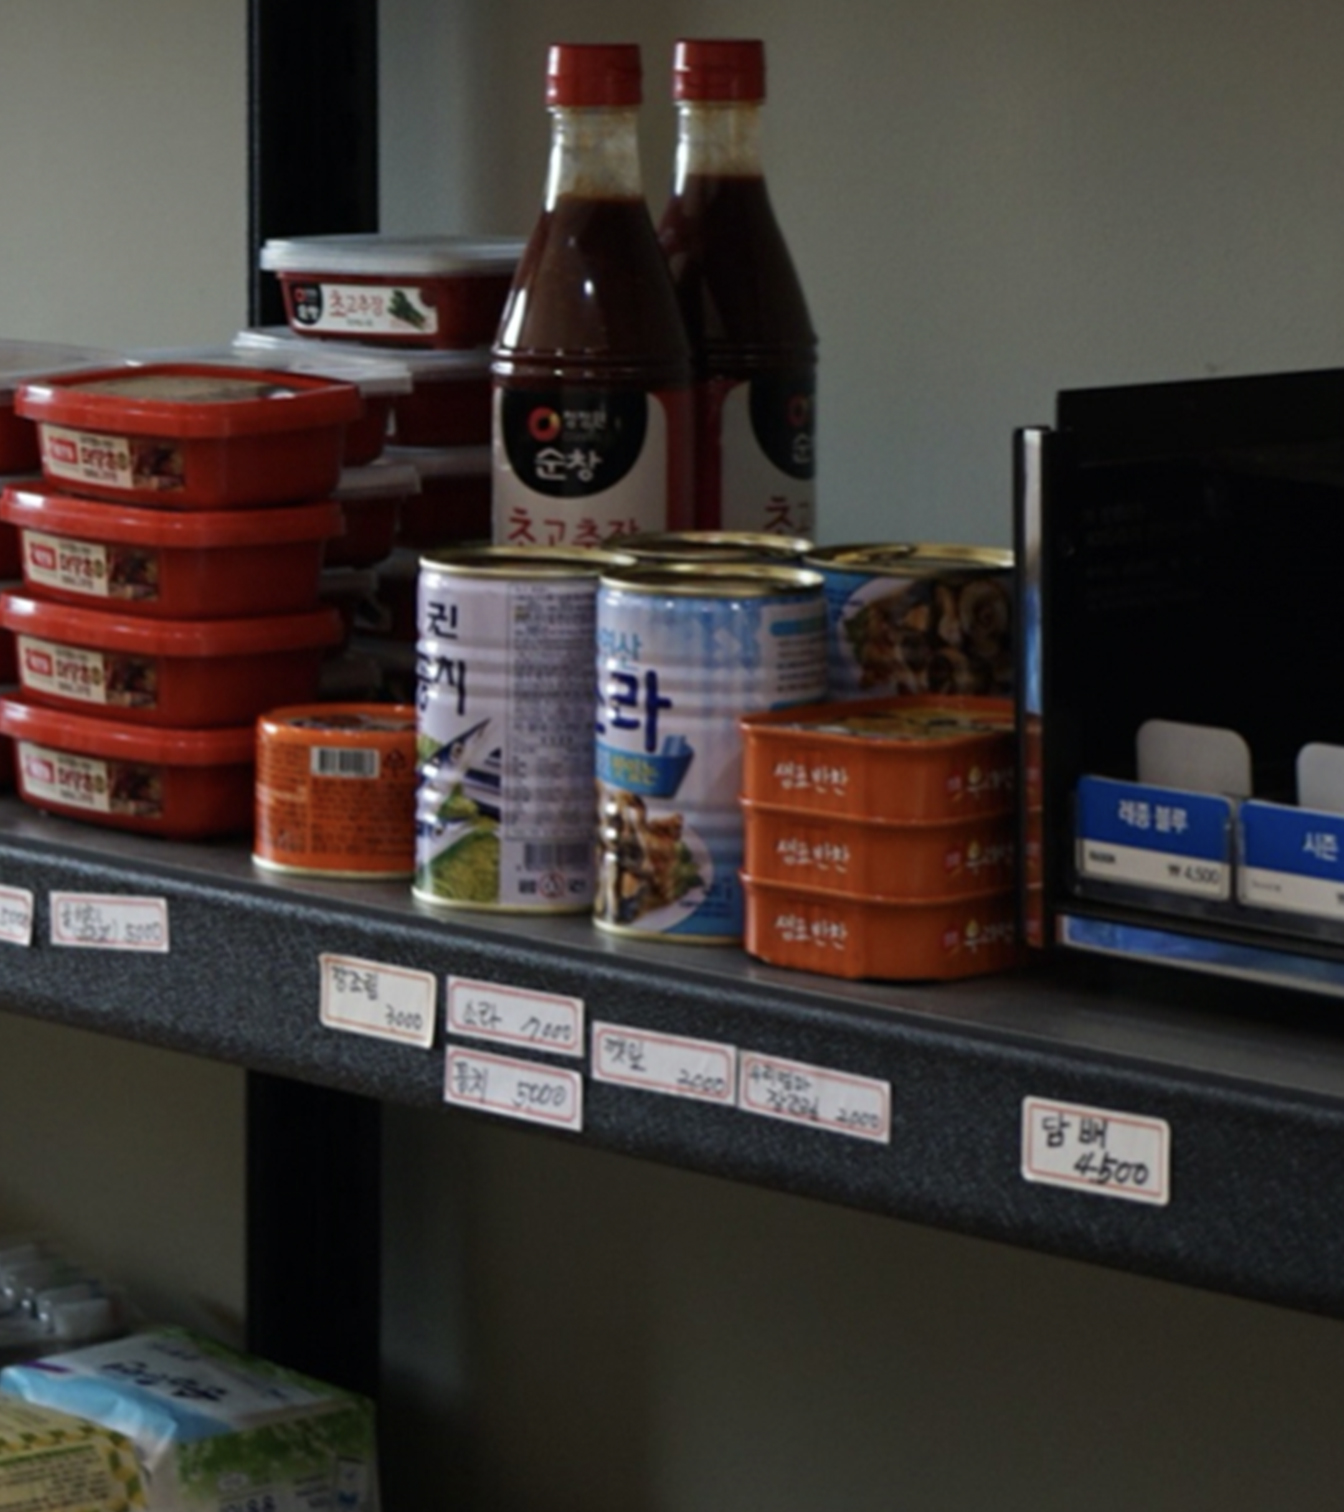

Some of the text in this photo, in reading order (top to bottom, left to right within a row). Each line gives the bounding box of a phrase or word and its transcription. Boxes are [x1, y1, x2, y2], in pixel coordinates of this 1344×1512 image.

[534, 445, 602, 483] 순창
[1155, 804, 1189, 835] 블루
[1302, 832, 1340, 863] 시즌
[1072, 1151, 1150, 1185] 4500
